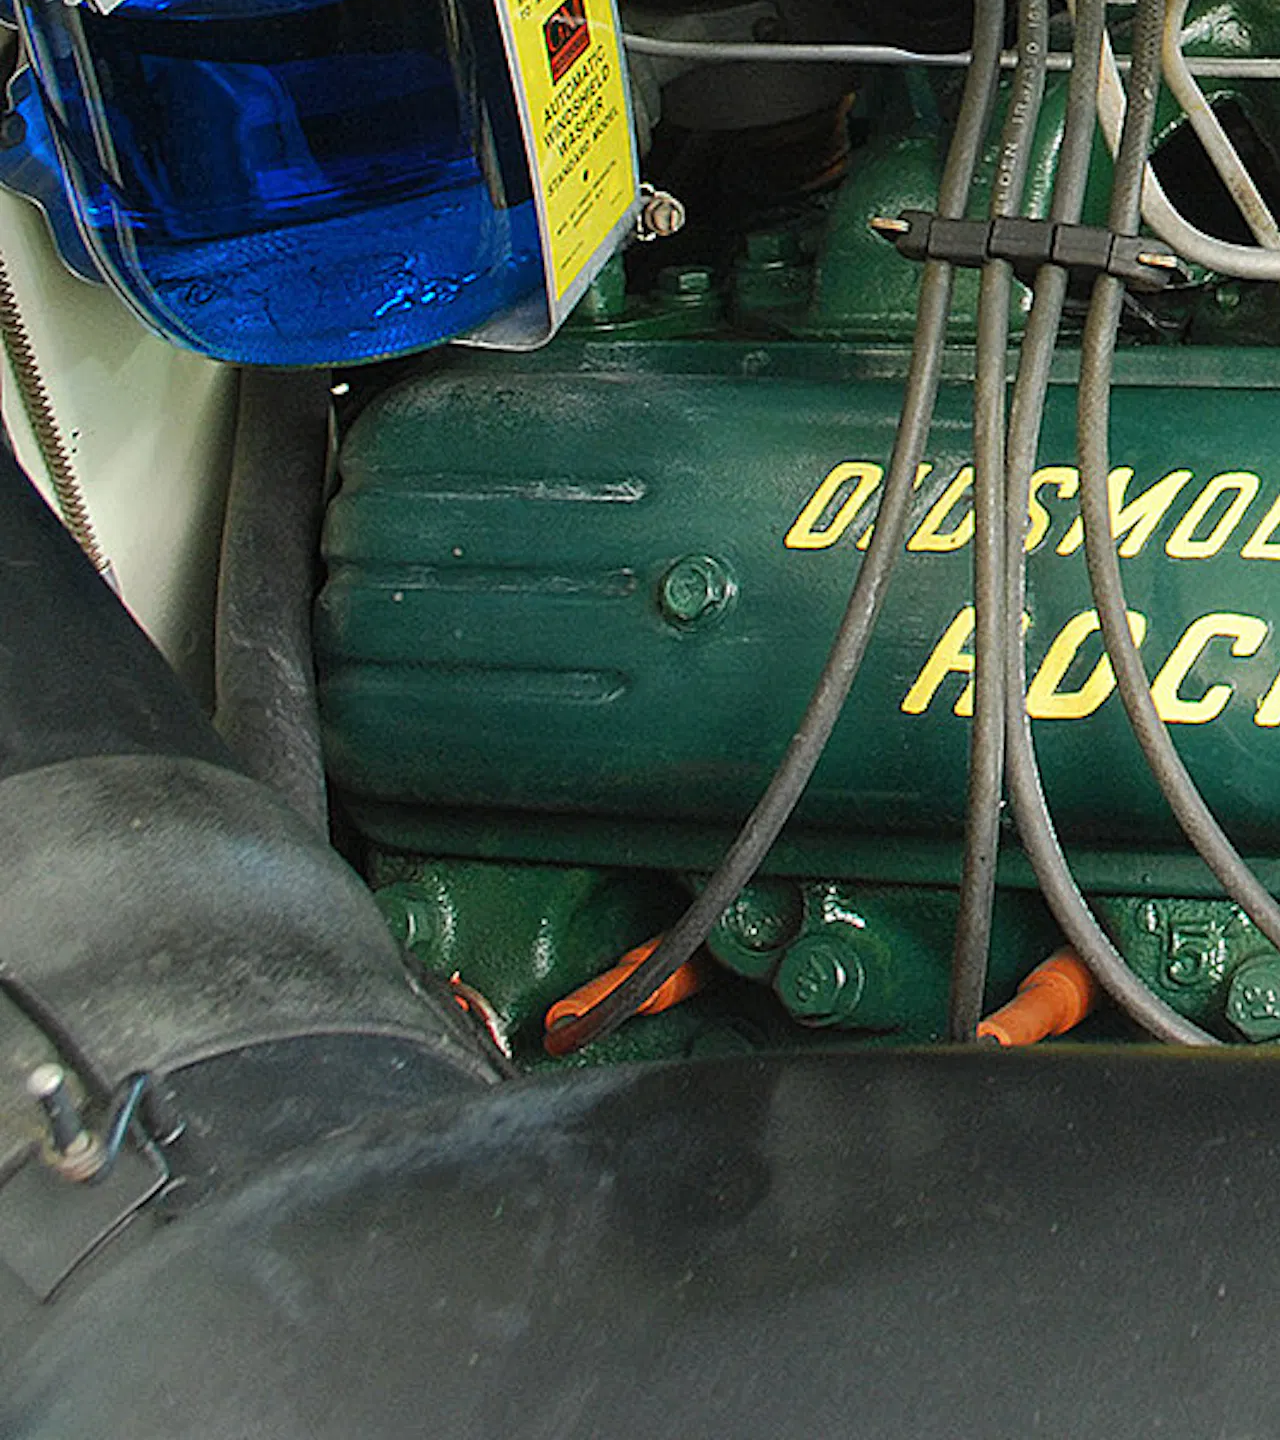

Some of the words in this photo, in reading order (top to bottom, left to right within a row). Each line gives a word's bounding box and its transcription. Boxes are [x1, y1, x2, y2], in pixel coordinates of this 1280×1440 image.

[543, 64, 610, 149] WINDSHIELD
[544, 43, 606, 124] AUTOMATIC
[557, 95, 604, 157] WASHER
[548, 139, 590, 197] STANDARD
